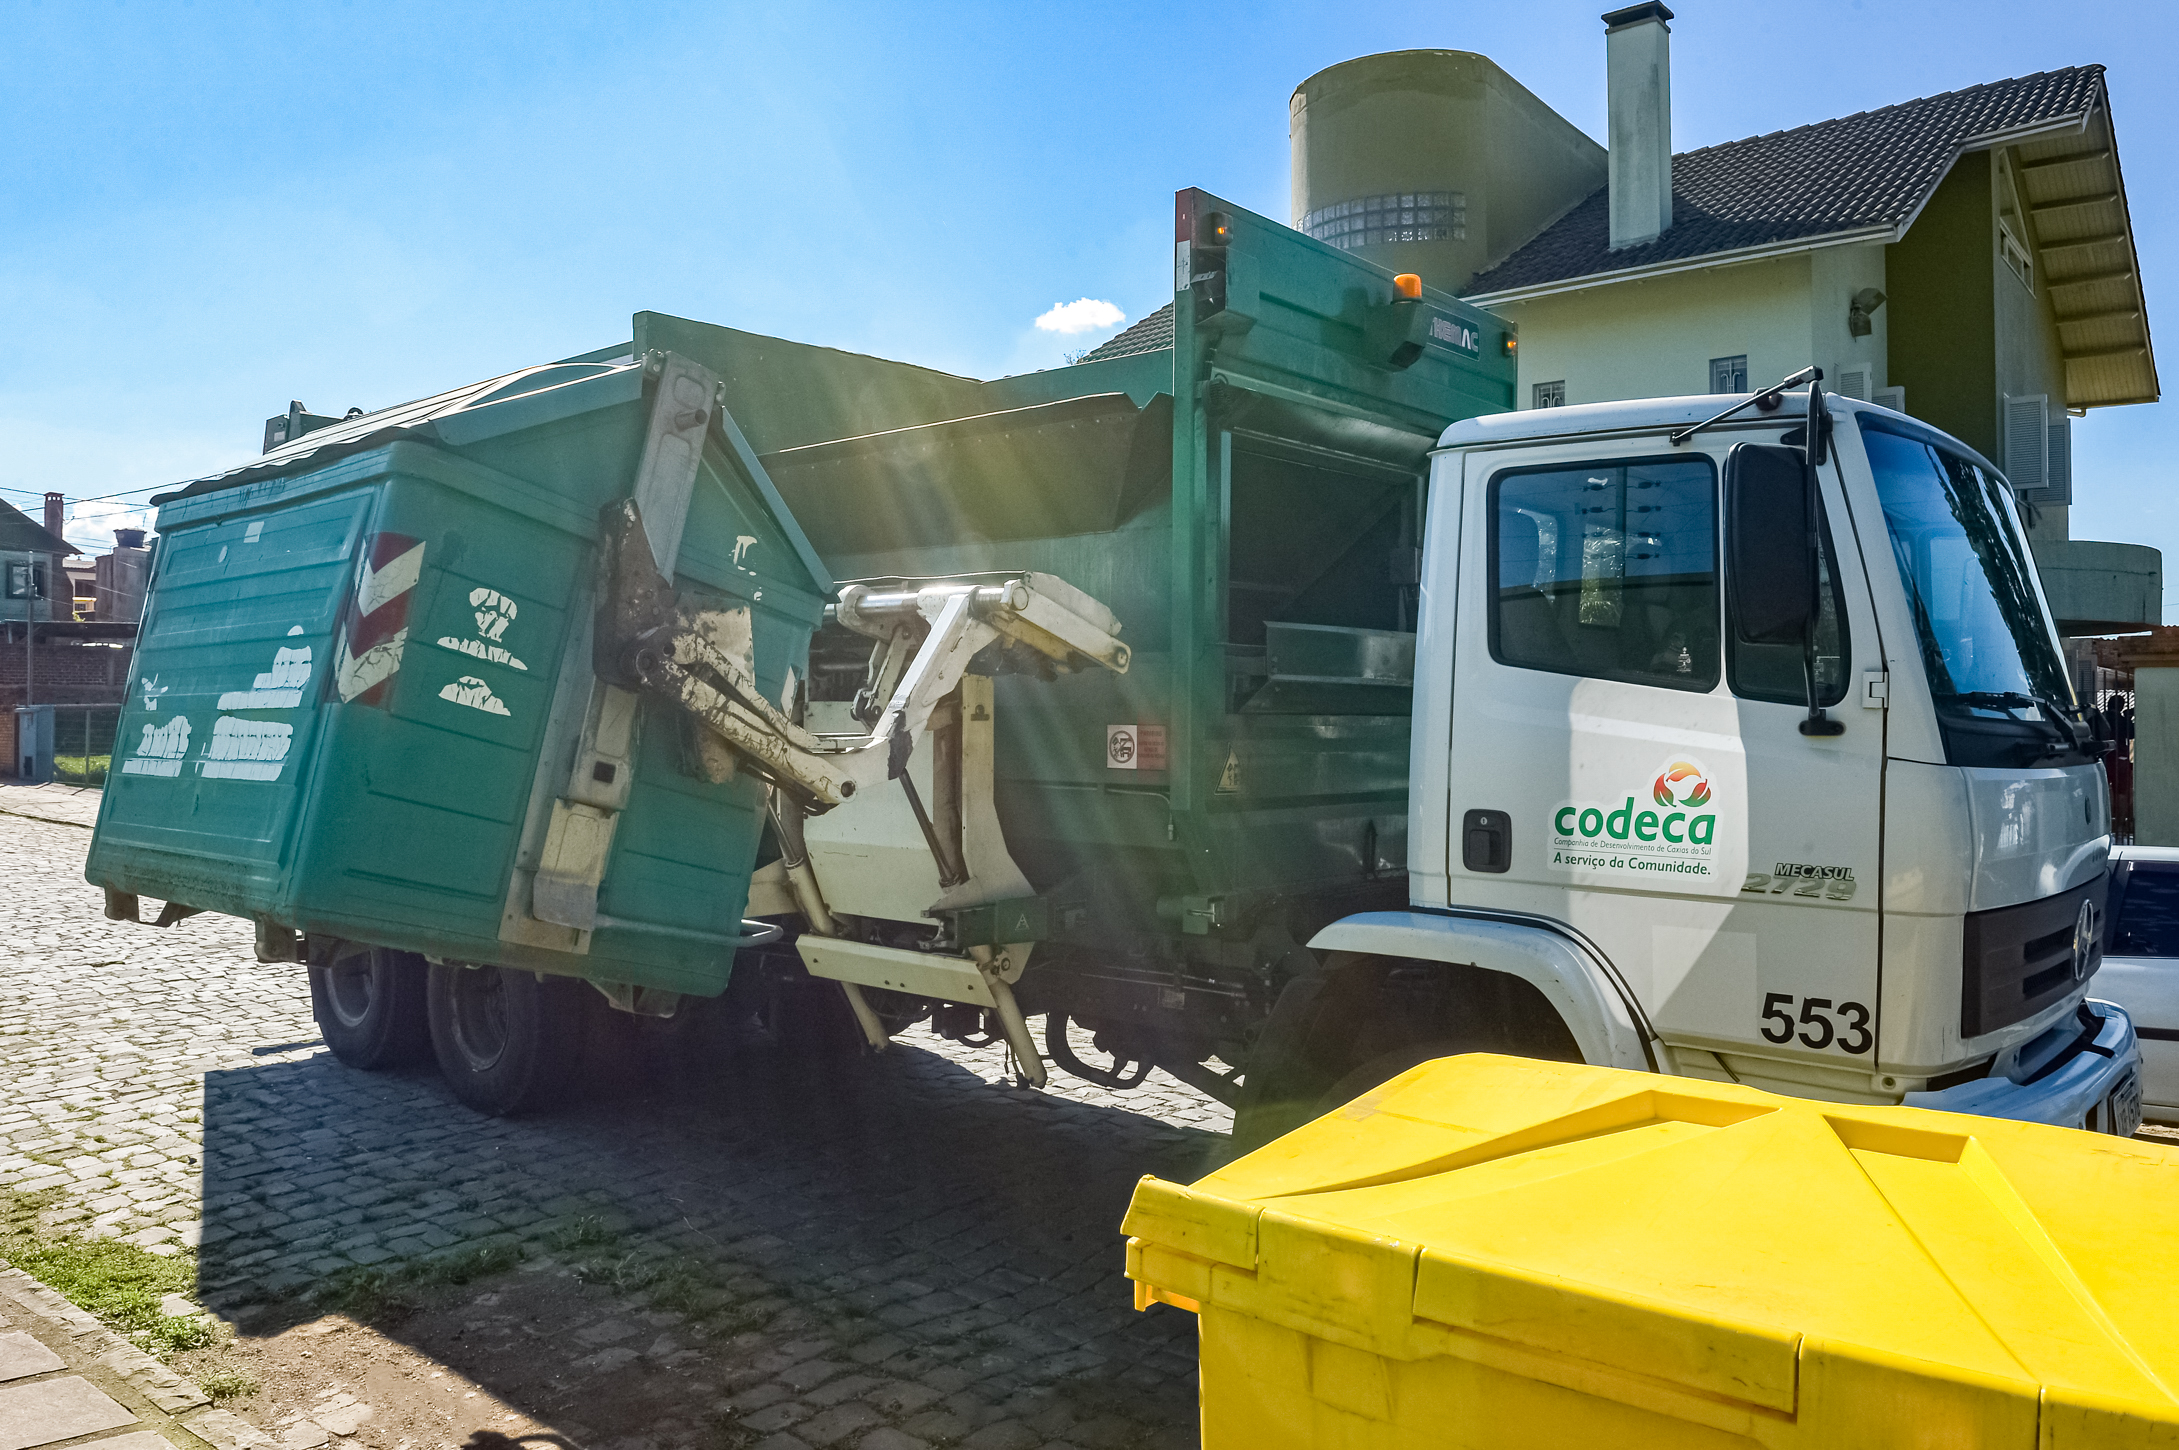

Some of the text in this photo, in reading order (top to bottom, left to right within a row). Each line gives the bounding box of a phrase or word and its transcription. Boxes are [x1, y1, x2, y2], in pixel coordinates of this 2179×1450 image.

[1554, 796, 1716, 845] codeca
[1554, 837, 1712, 856] Companhia de Desenvolvimento de Caxias do Sul
[1553, 851, 1711, 875] A serviço da Comunidade.
[1774, 862, 1855, 881] MECASUL
[1740, 872, 1857, 901] 2729
[1760, 991, 1873, 1055] 553
